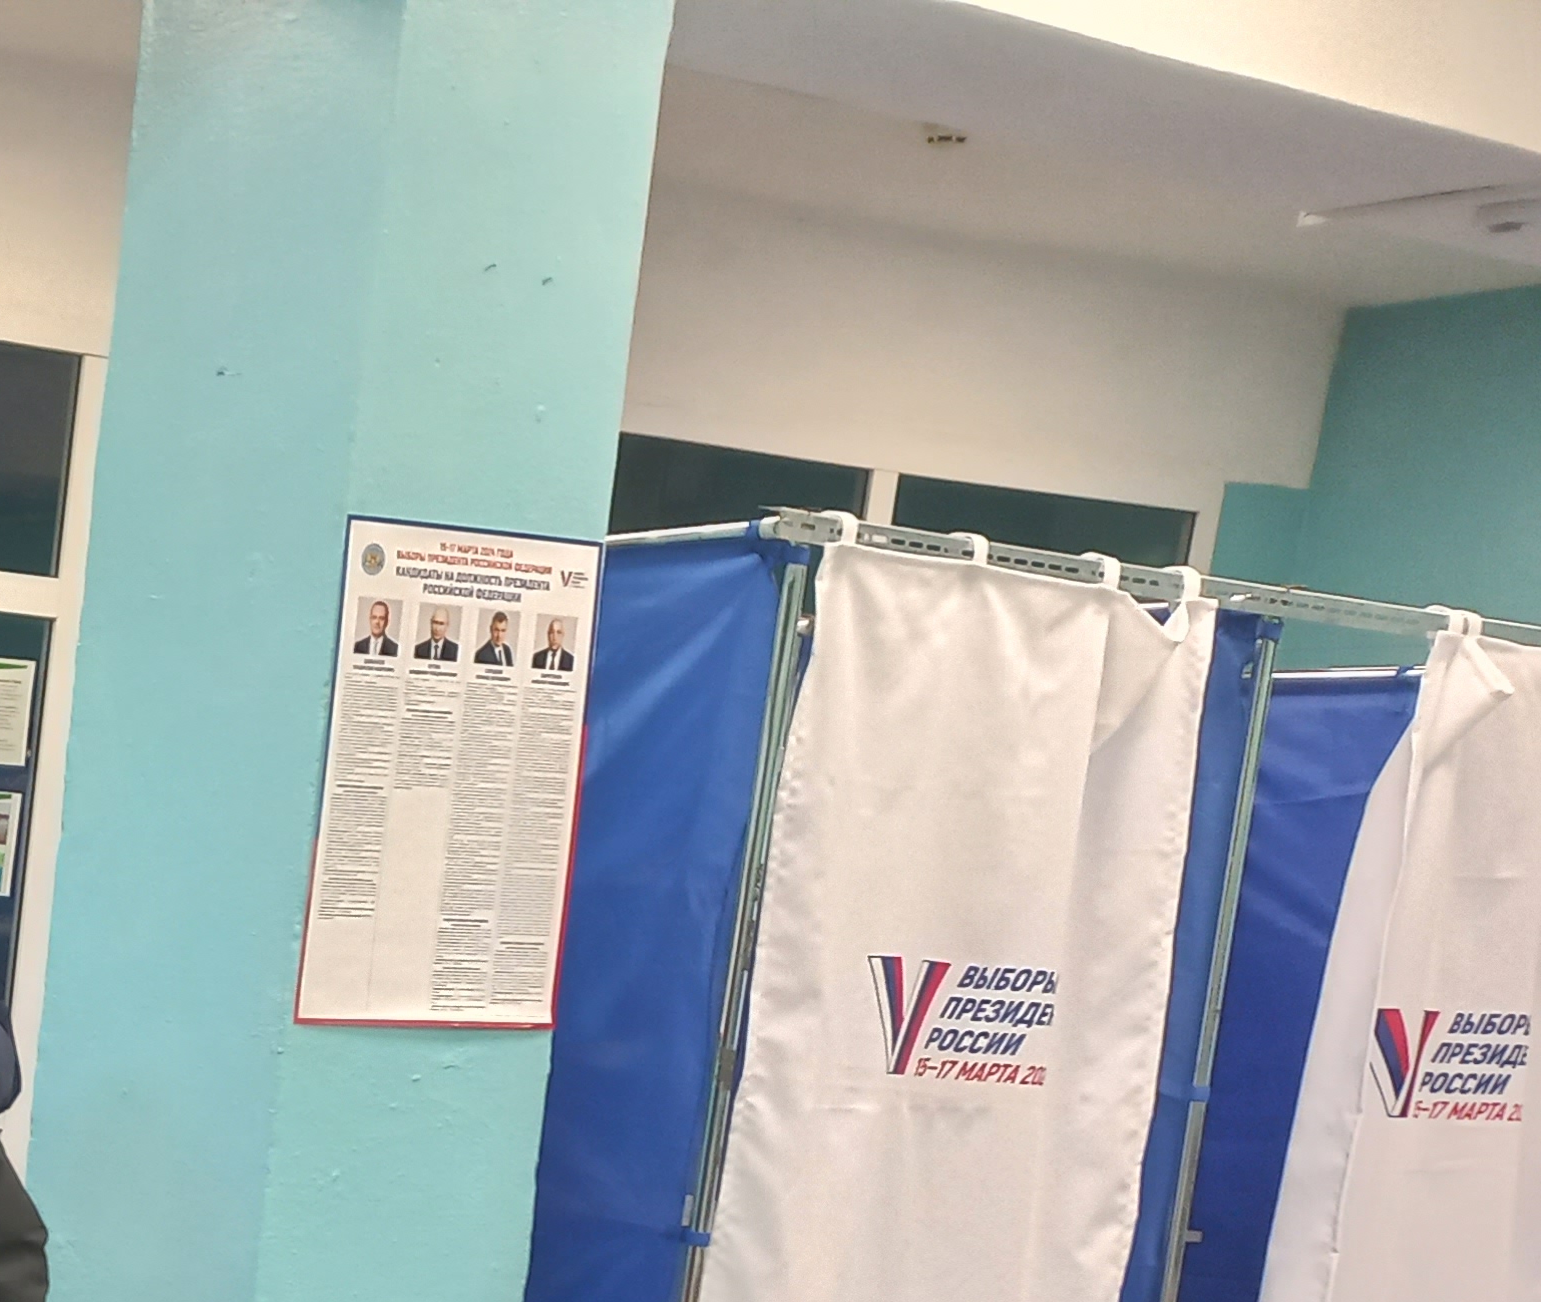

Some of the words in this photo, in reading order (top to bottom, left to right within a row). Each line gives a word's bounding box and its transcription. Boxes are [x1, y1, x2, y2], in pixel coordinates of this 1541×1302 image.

[924, 1027, 1027, 1056] РОССИИ
[955, 1060, 1020, 1084] МАРТА
[1418, 1071, 1512, 1095] РОССИИ
[1447, 1101, 1507, 1121] МАРТА
